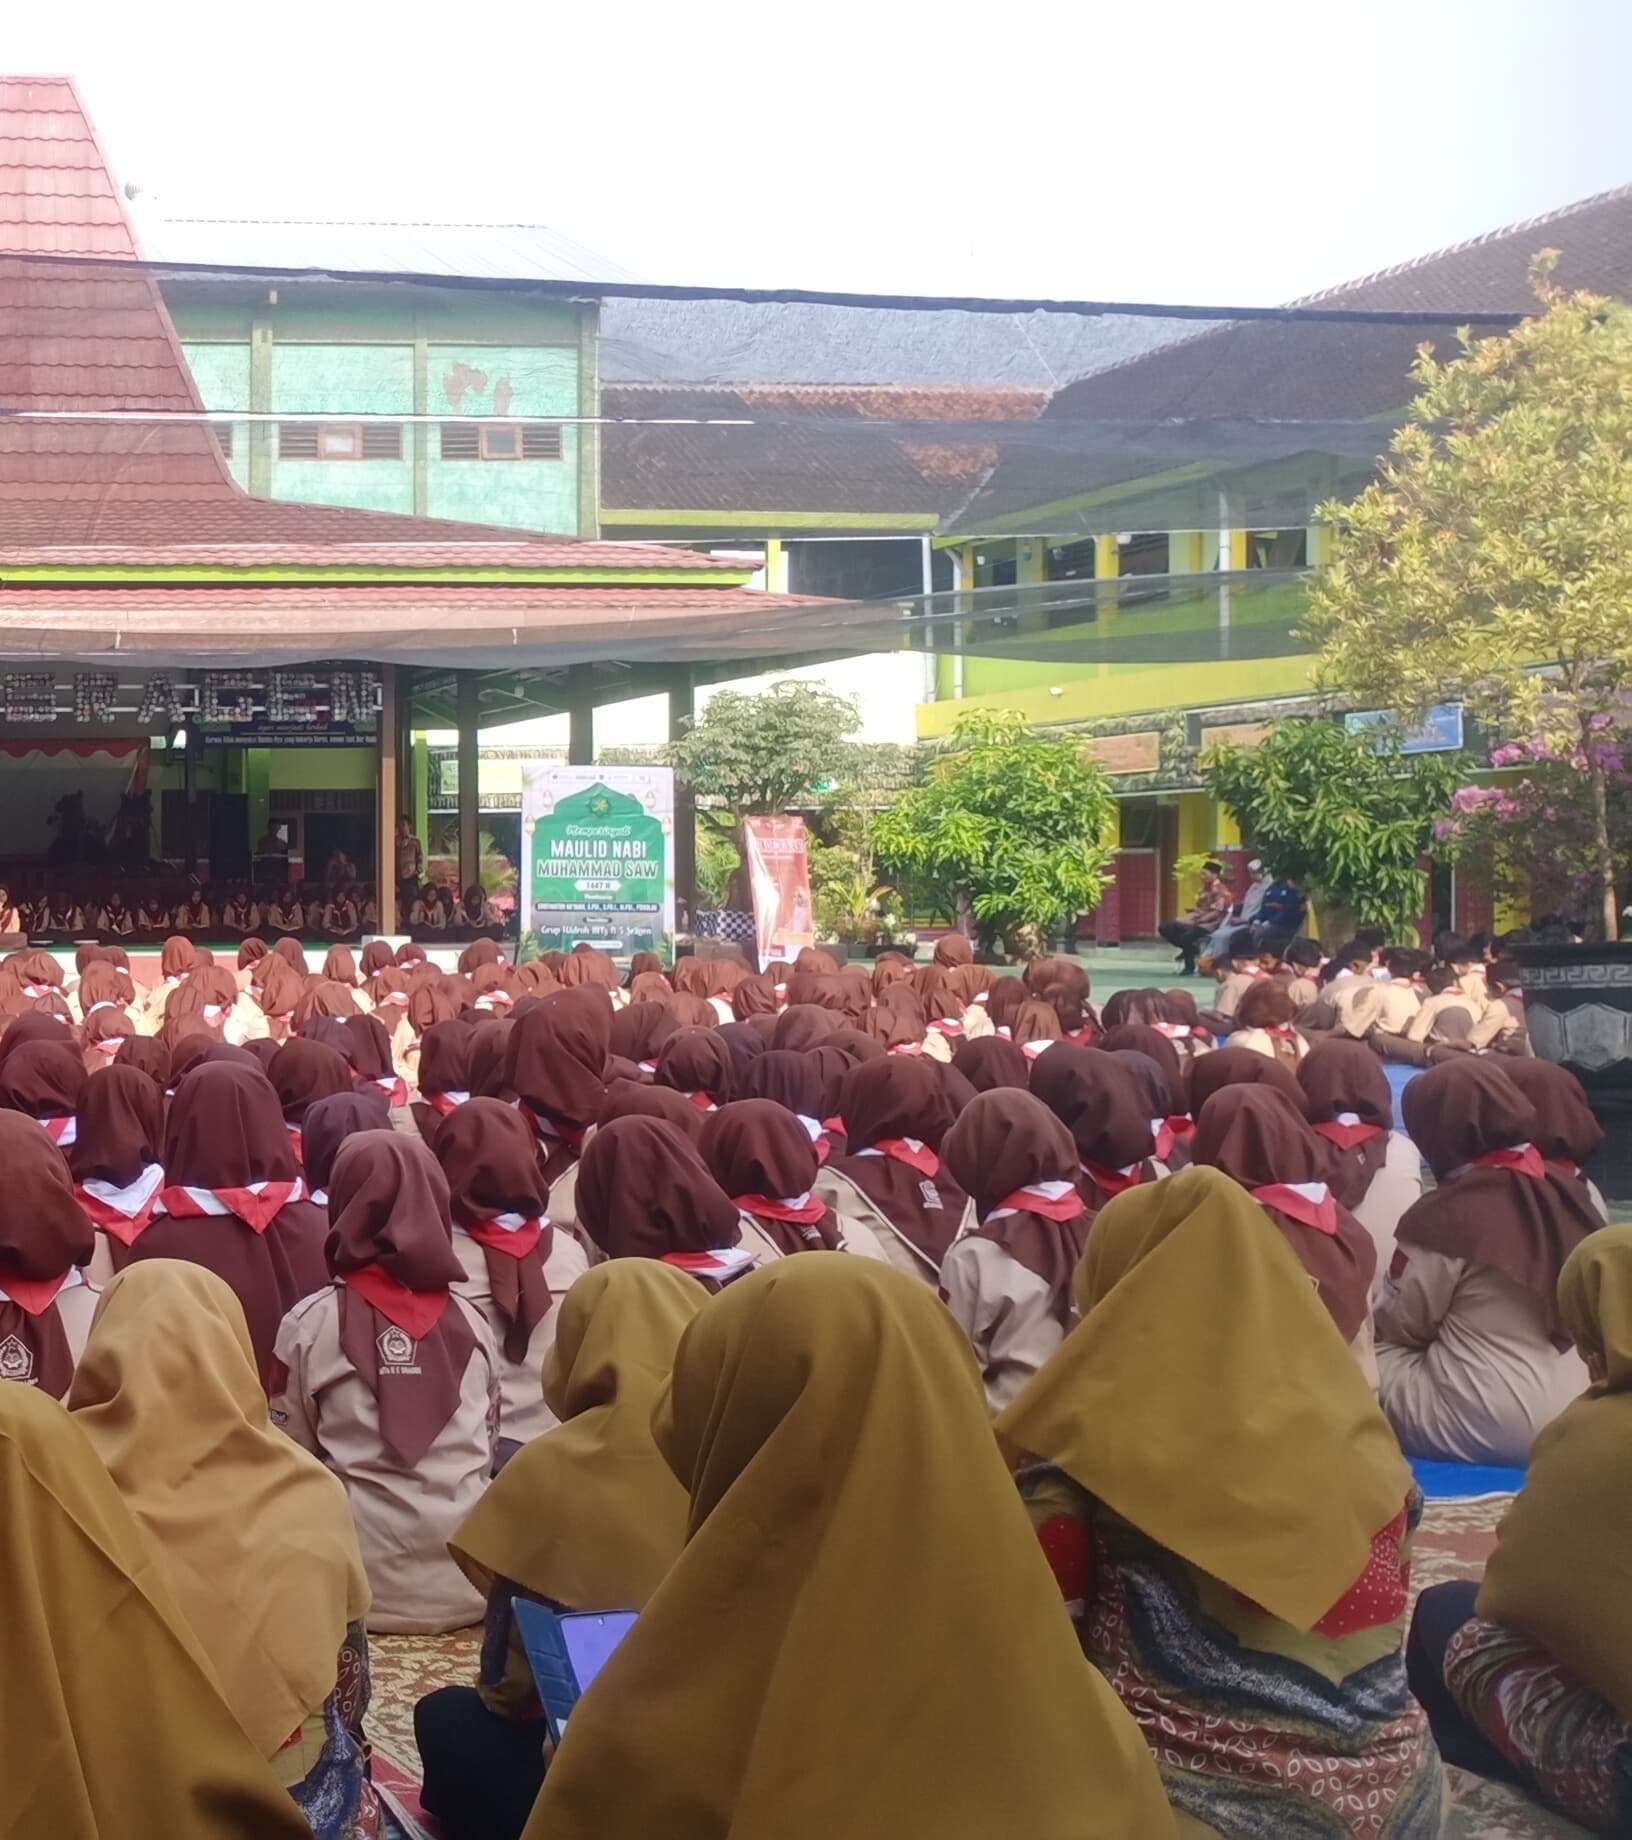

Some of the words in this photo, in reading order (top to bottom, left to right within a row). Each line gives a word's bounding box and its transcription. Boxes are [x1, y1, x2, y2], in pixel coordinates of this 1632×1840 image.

[551, 840, 607, 858] MAULID
[613, 840, 646, 858] NABI
[537, 860, 621, 878] MUHAMMAD
[625, 861, 658, 879] SAW
